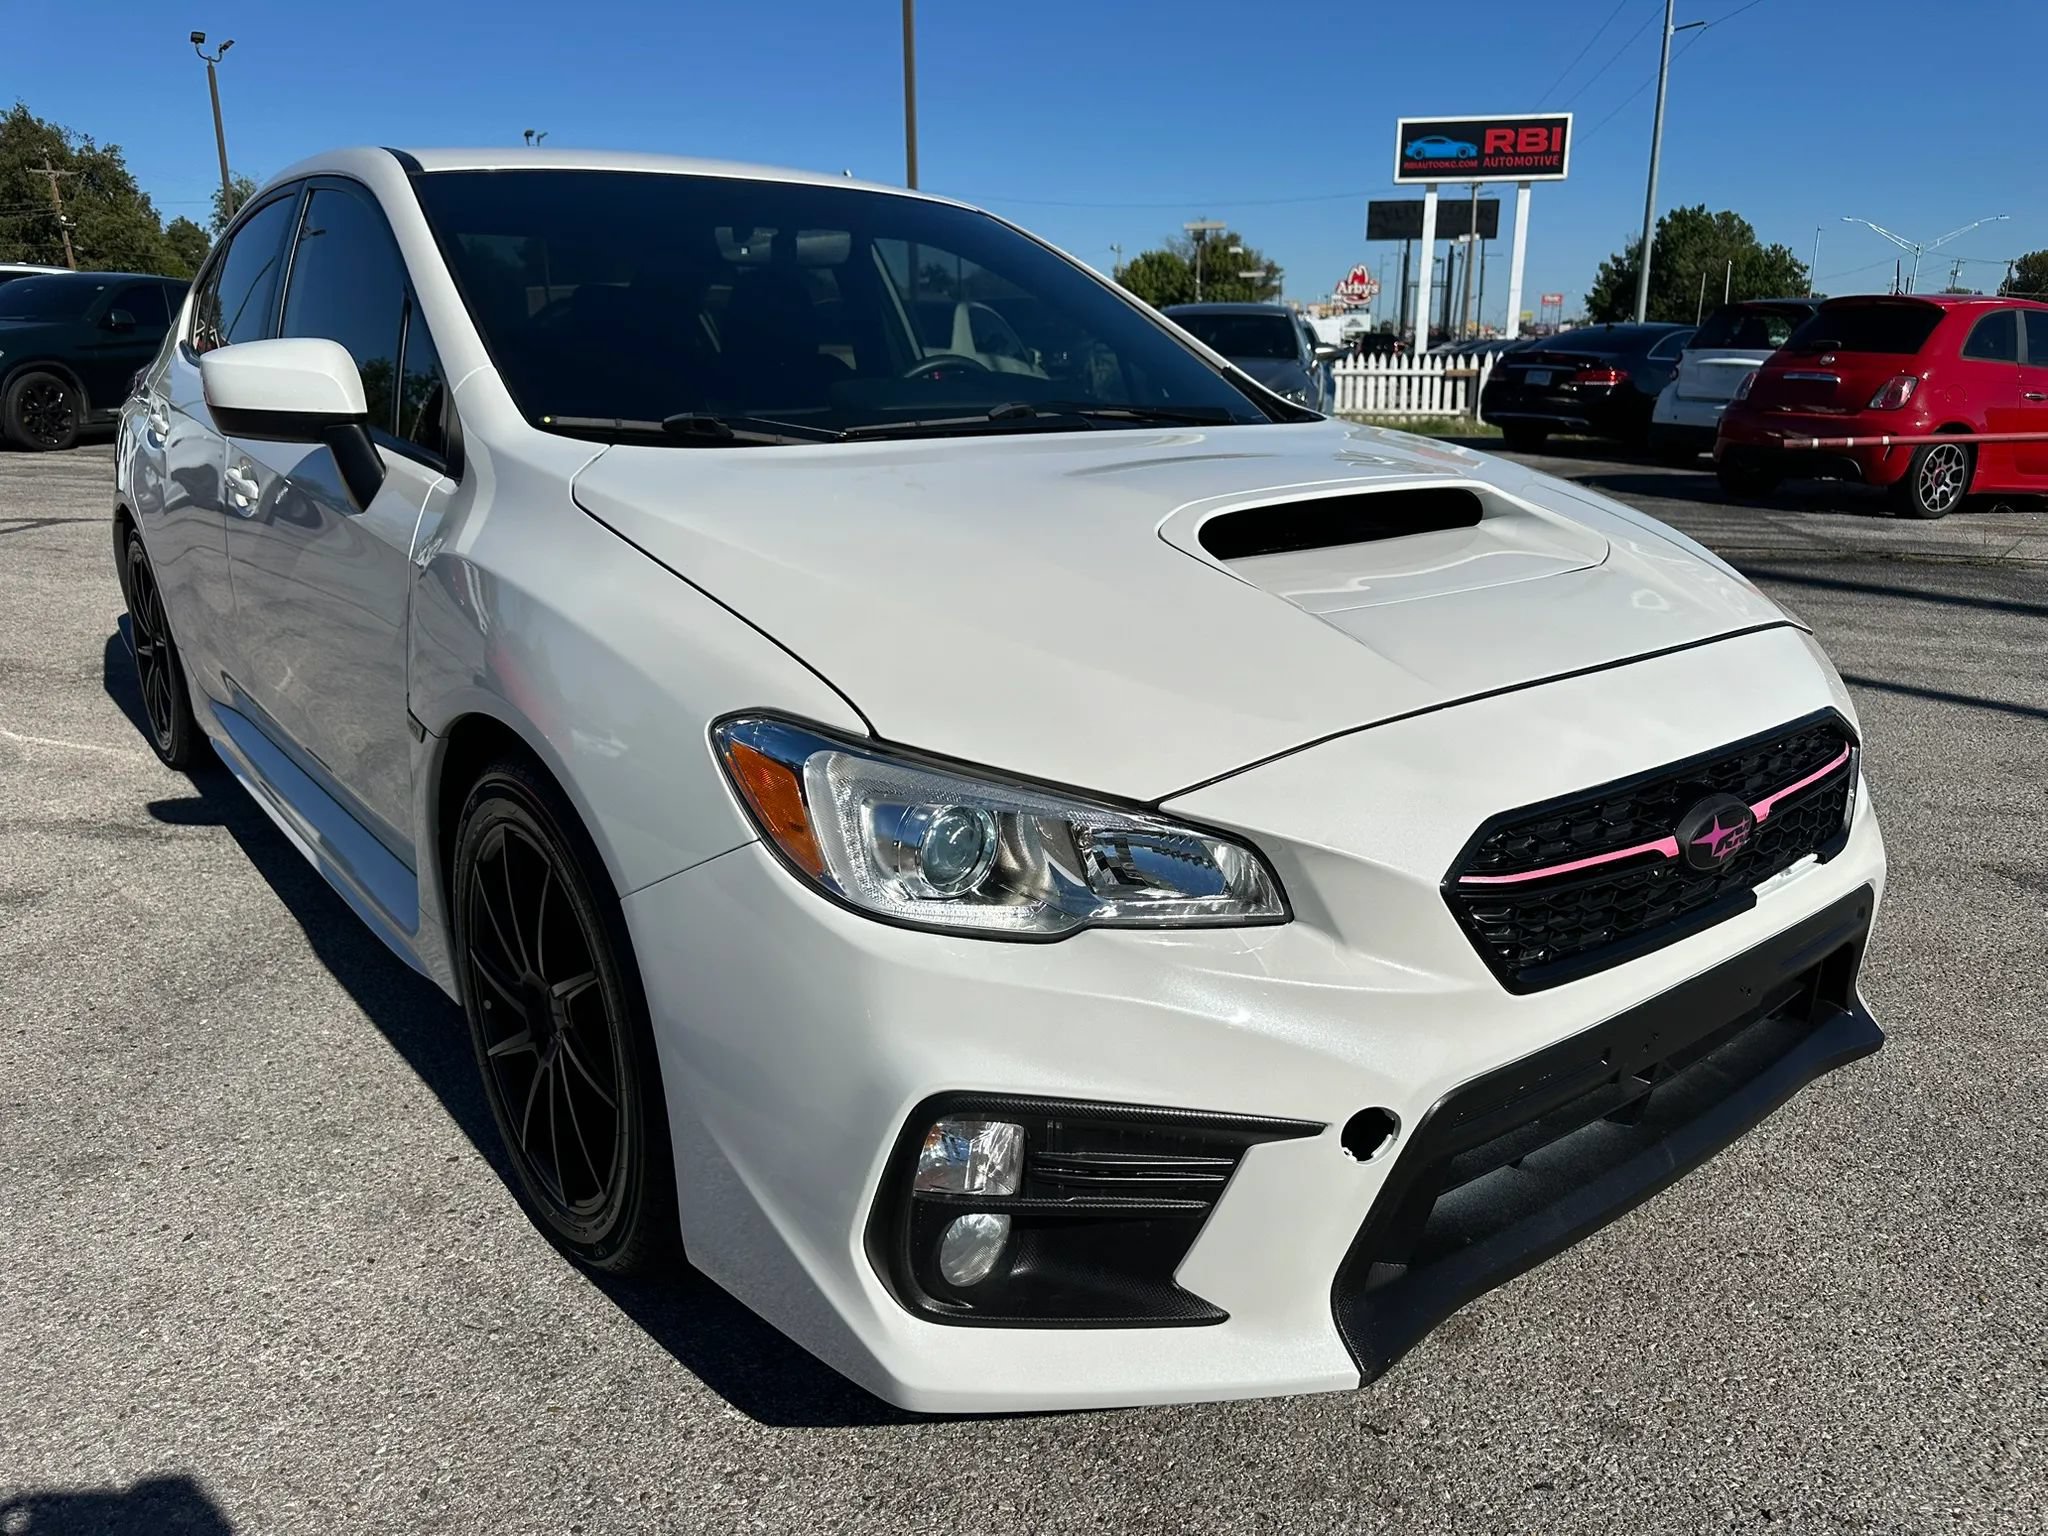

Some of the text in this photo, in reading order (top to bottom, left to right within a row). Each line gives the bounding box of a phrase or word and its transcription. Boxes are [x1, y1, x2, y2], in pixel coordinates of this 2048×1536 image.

[1484, 127, 1562, 154] RBI
[1483, 155, 1560, 167] AUTOMOTIVE
[1337, 280, 1379, 297] Arby's
